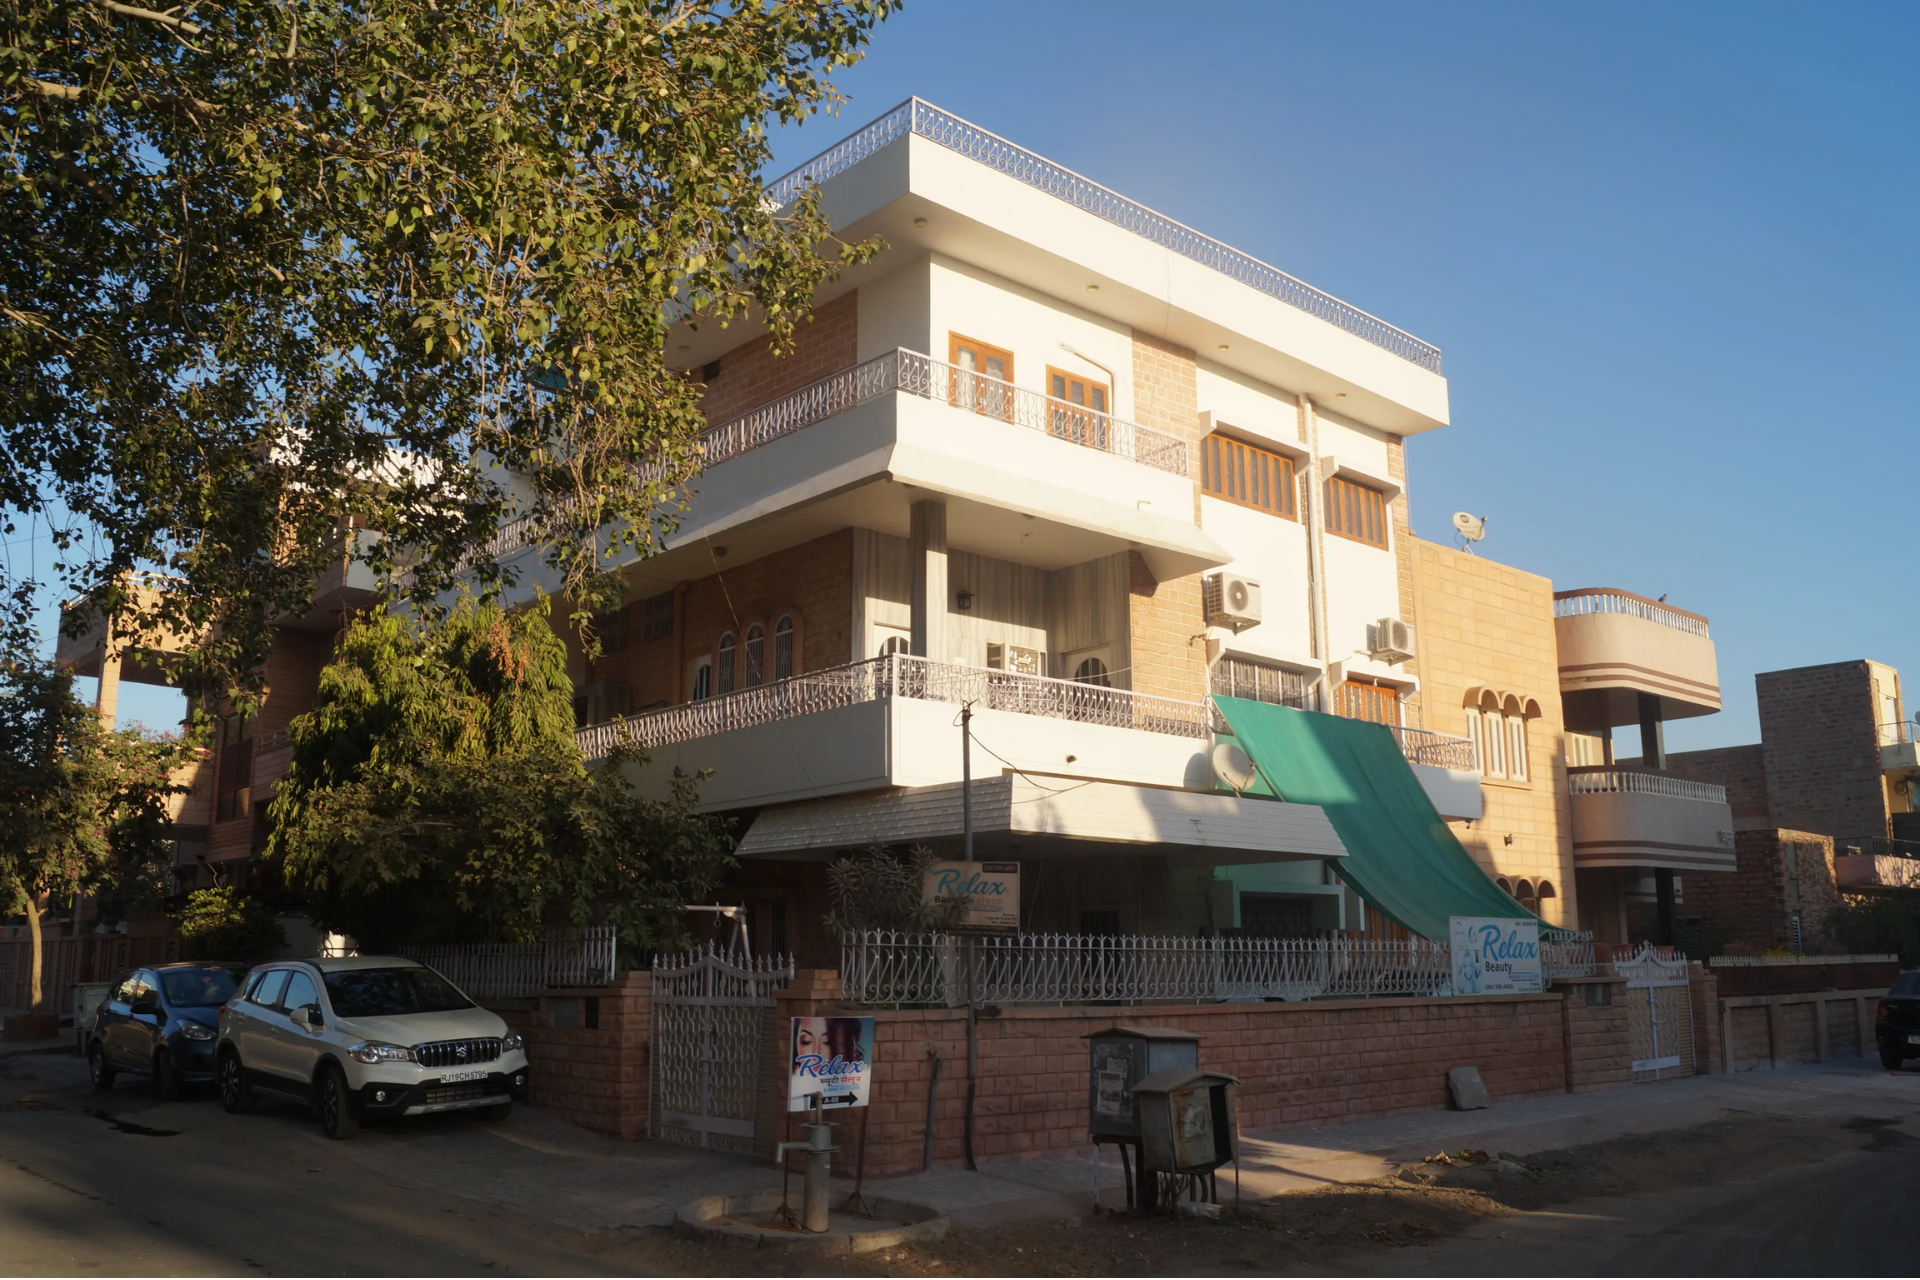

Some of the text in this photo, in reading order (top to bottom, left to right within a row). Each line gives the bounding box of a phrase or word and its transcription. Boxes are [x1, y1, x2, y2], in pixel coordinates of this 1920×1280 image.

[934, 869, 1007, 896] Relax
[1479, 924, 1538, 962] Relax
[1485, 961, 1513, 976] Beauty
[796, 1054, 865, 1077] Relax
